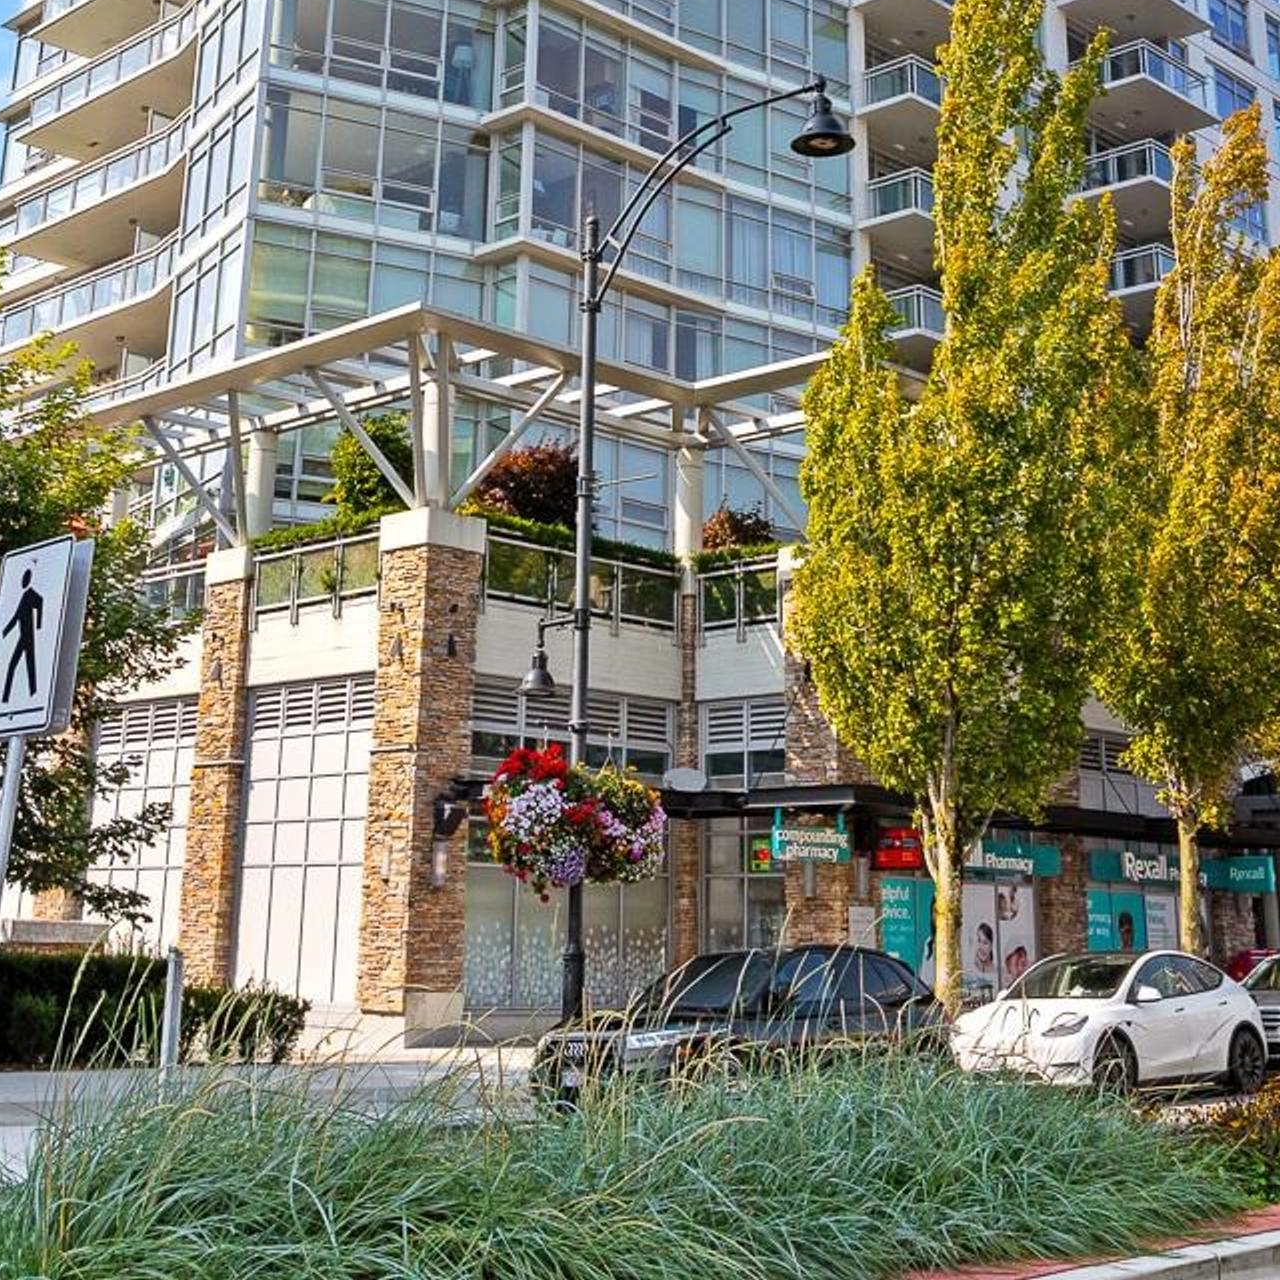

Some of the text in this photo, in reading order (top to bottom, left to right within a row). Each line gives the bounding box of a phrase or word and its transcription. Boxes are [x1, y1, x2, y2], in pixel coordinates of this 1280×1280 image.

[776, 828, 848, 848] compounding
[786, 843, 839, 862] pharmacy
[986, 853, 1034, 873] Pharmacy
[1124, 852, 1167, 881] Rexall
[1230, 867, 1265, 881] Rexall
